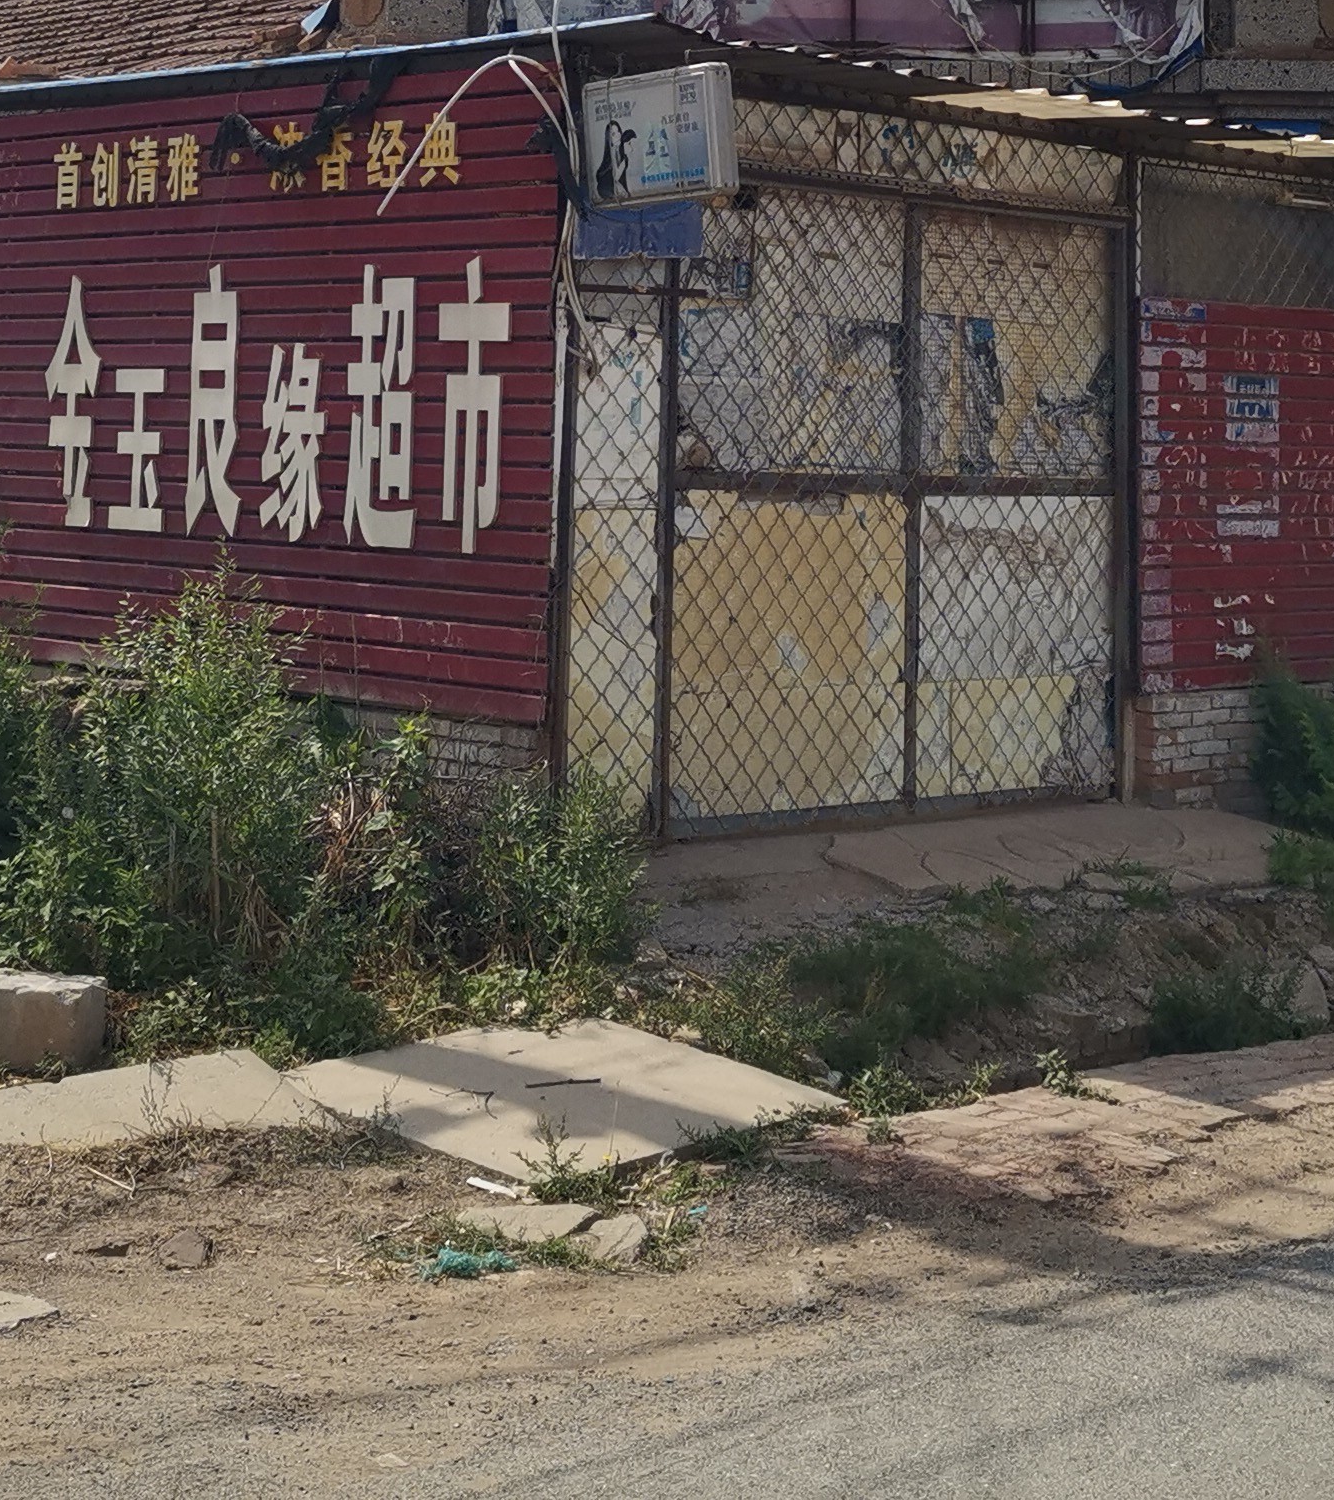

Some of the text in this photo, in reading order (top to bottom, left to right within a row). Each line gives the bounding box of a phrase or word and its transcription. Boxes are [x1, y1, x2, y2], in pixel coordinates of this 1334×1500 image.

[45, 255, 512, 555] 金玉良缘超市
